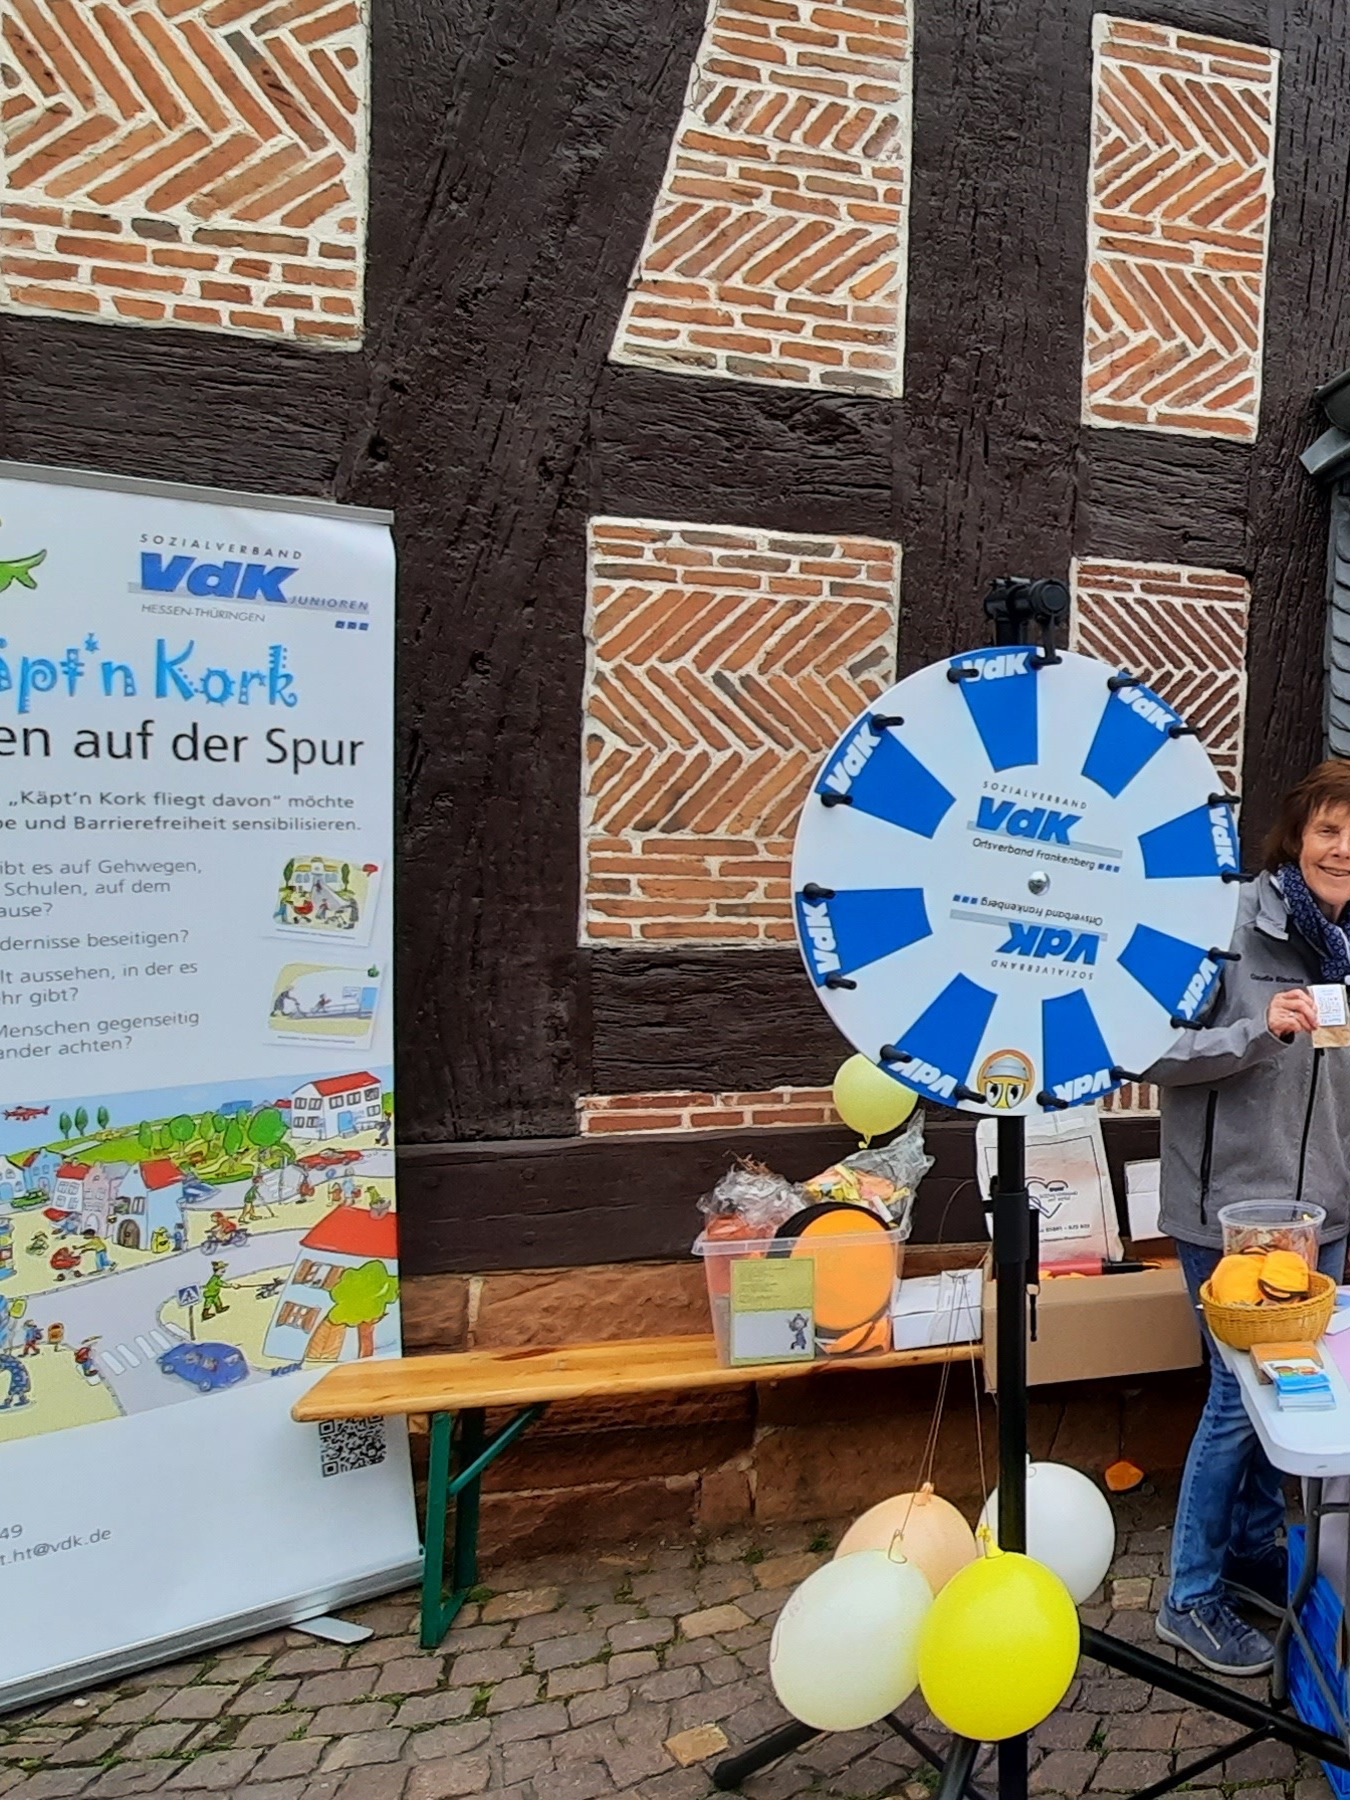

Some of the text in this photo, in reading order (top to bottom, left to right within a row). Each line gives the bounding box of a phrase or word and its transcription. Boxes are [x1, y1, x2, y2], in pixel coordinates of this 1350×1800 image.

[140, 533, 302, 560] SOZIALVERBAND
[140, 552, 370, 612] VdK JUNIOREN
[141, 603, 265, 623] HESSEN-THÜRINGEN
[156, 638, 298, 708] Kork
[962, 652, 1030, 683] VdK
[1117, 686, 1176, 732] VdK
[74, 720, 154, 760] auf
[172, 722, 247, 763] der
[266, 727, 364, 774] Spur
[825, 722, 881, 795] VdK
[99, 791, 147, 807] Kork
[153, 791, 207, 810] fliegt
[288, 794, 354, 809] möchte
[983, 781, 1087, 810] SOZIALVERBAND
[25, 815, 66, 830] und
[74, 815, 226, 831] Barrierefreiheit
[232, 817, 362, 831] sensibilisieren.
[976, 795, 1082, 845] VdK
[1209, 806, 1237, 868] VdK
[32, 863, 53, 875] es
[60, 859, 91, 875] auf
[98, 860, 202, 876] Gehwegen,
[973, 838, 1096, 870] Ortsverband Frankenberg
[4, 879, 171, 897] Schulen, auf dem
[980, 897, 1103, 927] Ortsverband Frankenberg
[87, 929, 189, 949] beseitigen?
[801, 901, 841, 974] VdK
[995, 922, 1100, 966] VdK
[20, 966, 116, 983] aussehen,
[122, 963, 138, 978] in
[145, 961, 173, 977] der
[179, 962, 198, 974] es
[991, 959, 1094, 981] SOZIALVERBAND
[29, 987, 78, 1007] gibt?
[1176, 957, 1219, 1020] VdK
[97, 1011, 199, 1035] gegenseitig
[59, 1036, 133, 1055] achten?
[888, 1057, 958, 1098] VdK
[1053, 1069, 1112, 1102] VdK
